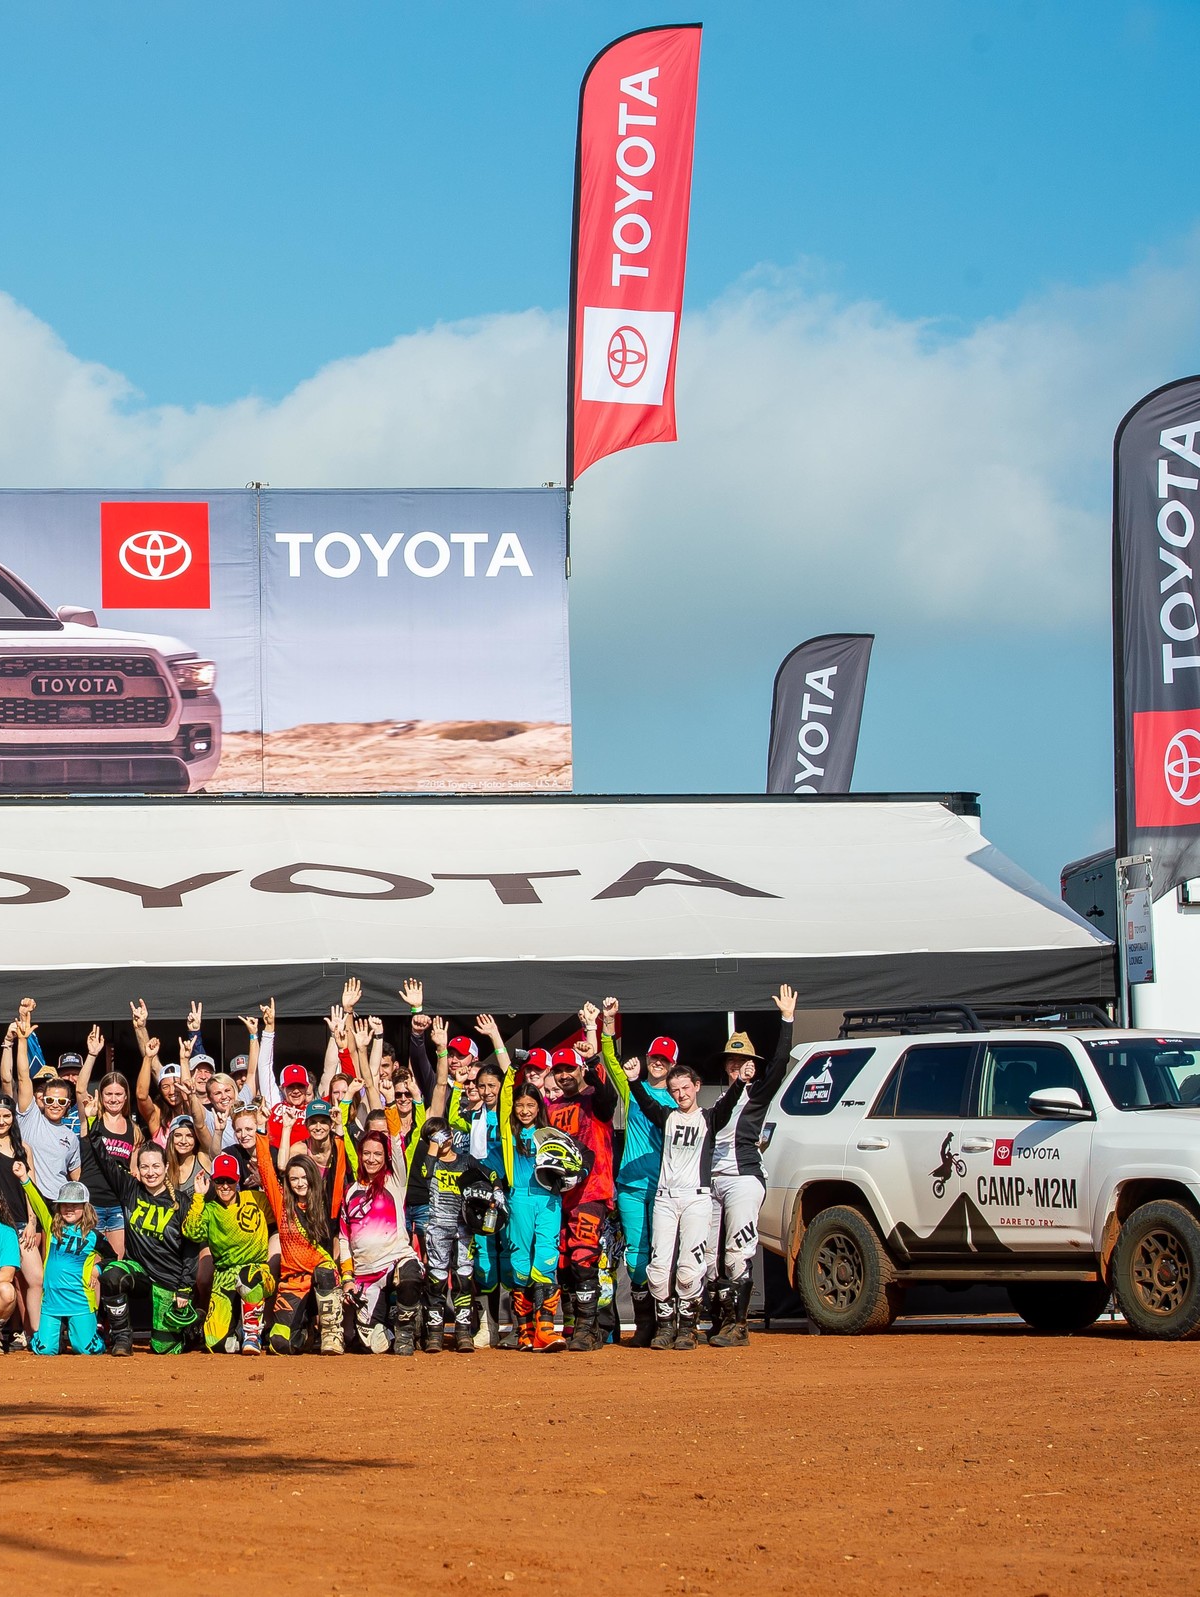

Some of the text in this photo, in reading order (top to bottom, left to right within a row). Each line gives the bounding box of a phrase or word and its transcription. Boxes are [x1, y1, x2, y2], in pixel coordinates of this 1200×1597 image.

[611, 66, 660, 287] TOYOTA
[275, 531, 534, 579] TOYOTA
[1156, 420, 1200, 684] TOYOTA
[38, 678, 118, 693] TOYOTA
[794, 666, 838, 793] YOTA
[447, 780, 477, 791] Toyota
[479, 780, 504, 789] Motor
[554, 1106, 576, 1129] FLY
[672, 1125, 699, 1147] FLY
[1017, 1147, 1060, 1160] TOYOTA
[977, 1175, 1077, 1209] CAMP M2M
[130, 1198, 174, 1233] FLY
[1000, 1217, 1021, 1225] DARE
[581, 1217, 595, 1242] FLY
[733, 1221, 757, 1249] FLY
[57, 1234, 89, 1256] FLY
